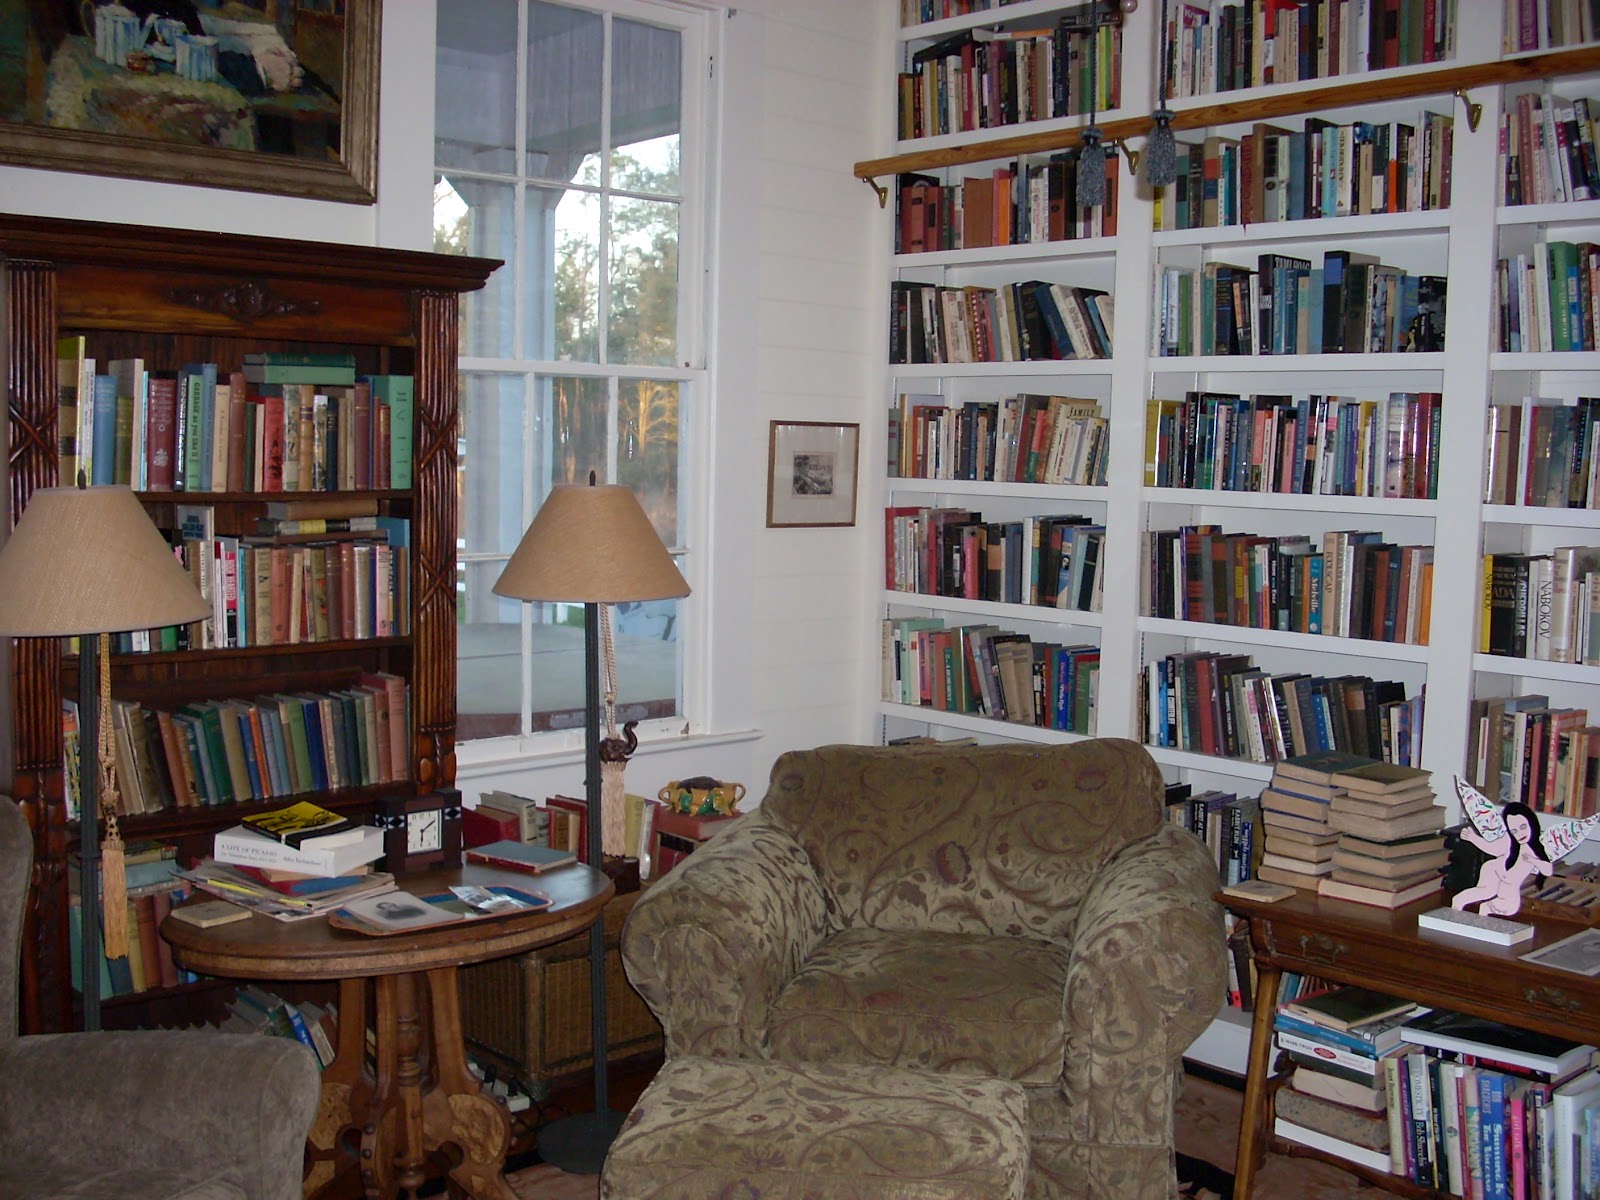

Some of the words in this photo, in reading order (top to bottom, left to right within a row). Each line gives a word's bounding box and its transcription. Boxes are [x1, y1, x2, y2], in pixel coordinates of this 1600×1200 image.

[1275, 256, 1292, 269] TAMI
[193, 382, 201, 414] GARBAGE
[1069, 407, 1095, 418] FAMILY
[1189, 401, 1197, 418] JACK
[190, 424, 198, 437] you
[1188, 418, 1196, 445] LONDON
[191, 437, 199, 449] like
[1325, 551, 1333, 593] FOOLSCAP
[1310, 577, 1319, 613] Melville
[1484, 573, 1493, 611] NABOKOV
[1515, 581, 1527, 637] GUERRILLAS
[1539, 580, 1552, 640] NABOKOV
[1234, 809, 1242, 829] RABBIT
[1233, 830, 1242, 844] RUN
[251, 848, 278, 857] PICASSO
[295, 857, 322, 867] Richardson
[1411, 1068, 1423, 1117] DOMESTICITY
[1415, 1121, 1424, 1135] Bob
[1512, 1115, 1521, 1130] girl
[1513, 1132, 1522, 1149] talk
[1416, 1135, 1427, 1167] Shacochis
